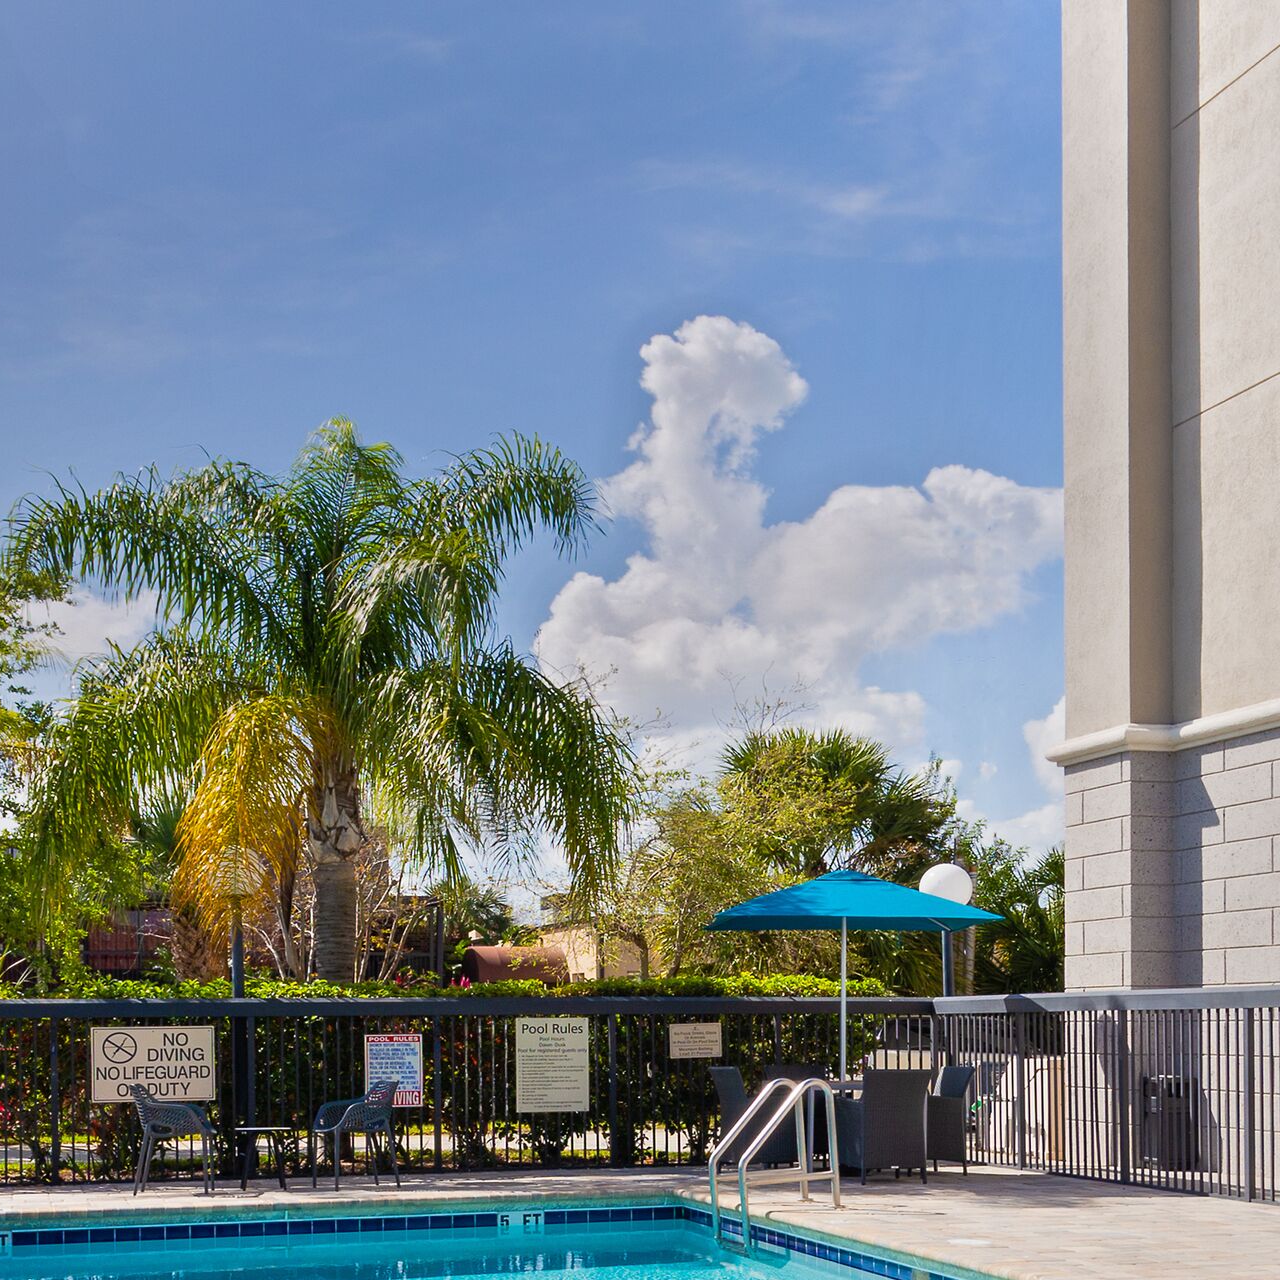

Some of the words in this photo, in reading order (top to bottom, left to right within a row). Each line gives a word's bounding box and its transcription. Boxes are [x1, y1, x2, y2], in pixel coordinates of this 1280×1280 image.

[521, 1023, 548, 1034] Pool
[552, 1023, 583, 1034] Rules
[163, 1033, 188, 1046] NO
[148, 1048, 205, 1062] DIVING
[96, 1067, 120, 1080] NO
[124, 1065, 210, 1080] LIFEGUARD
[149, 1082, 191, 1096] DUTY
[394, 1091, 419, 1105] IVING
[500, 1215, 509, 1226] 5
[523, 1213, 541, 1225] FT
